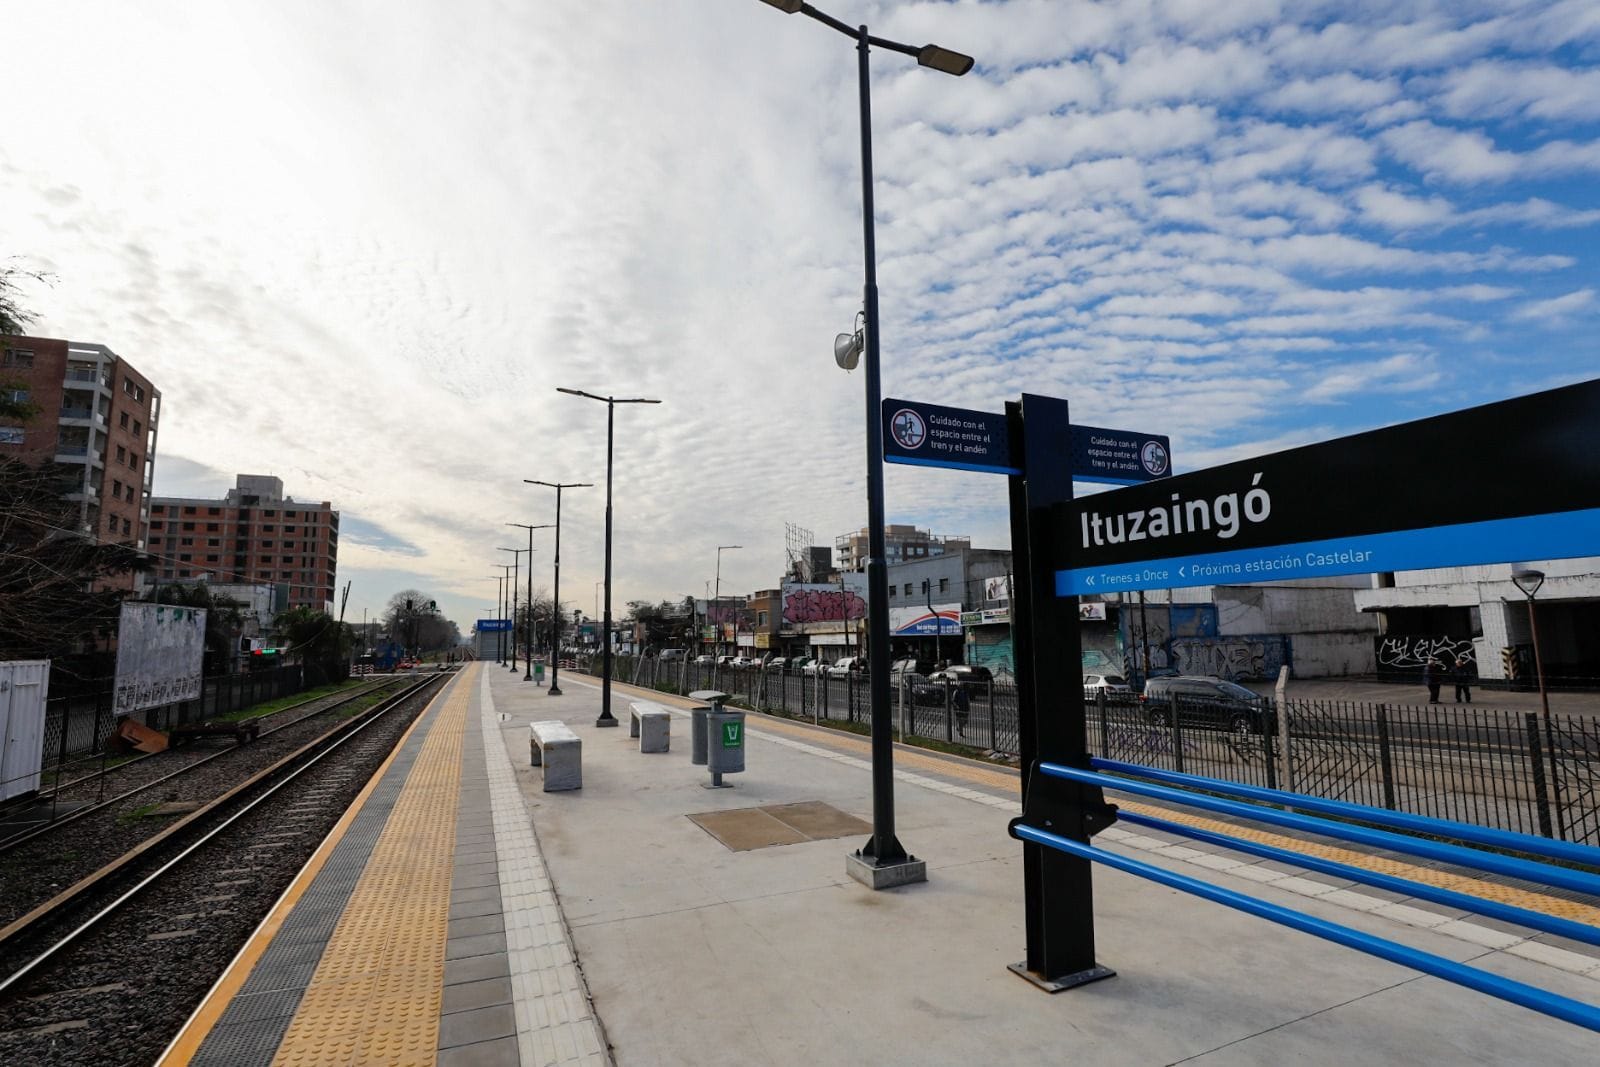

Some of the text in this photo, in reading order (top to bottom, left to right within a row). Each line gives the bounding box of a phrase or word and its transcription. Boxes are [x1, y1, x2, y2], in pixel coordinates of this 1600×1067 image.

[930, 414, 986, 430] Cuidado con el
[930, 428, 991, 443] espacio entre el
[1090, 436, 1137, 449] Cuidado con el
[931, 440, 987, 454] tren y el andén
[1087, 448, 1138, 460] espacio entre el
[1091, 459, 1139, 471] tren y el andén
[1080, 472, 1271, 549] Ituzaingó
[1100, 549, 1373, 586] Trenes a Once Próxima estación Castelar
